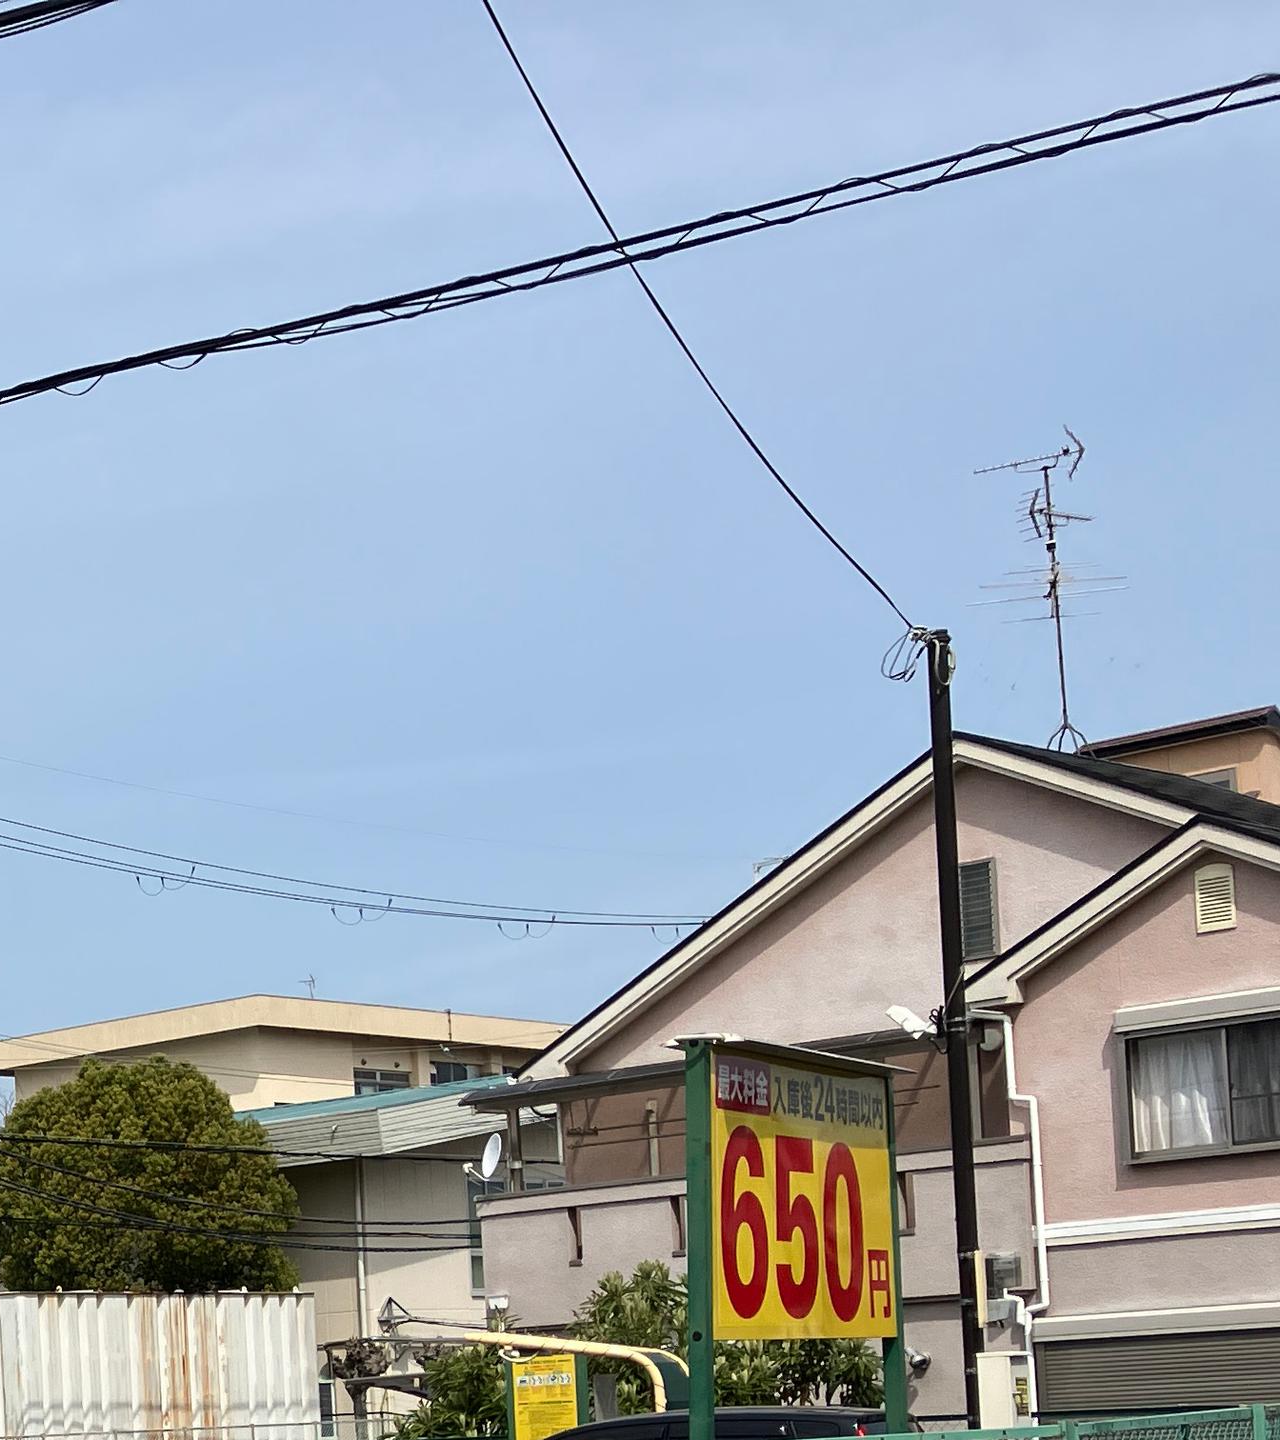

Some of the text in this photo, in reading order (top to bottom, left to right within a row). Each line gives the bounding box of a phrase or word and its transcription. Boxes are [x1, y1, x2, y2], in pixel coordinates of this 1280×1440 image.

[717, 1064, 769, 1107] 最大料金
[773, 1075, 884, 1130] 入庫後24時間以内
